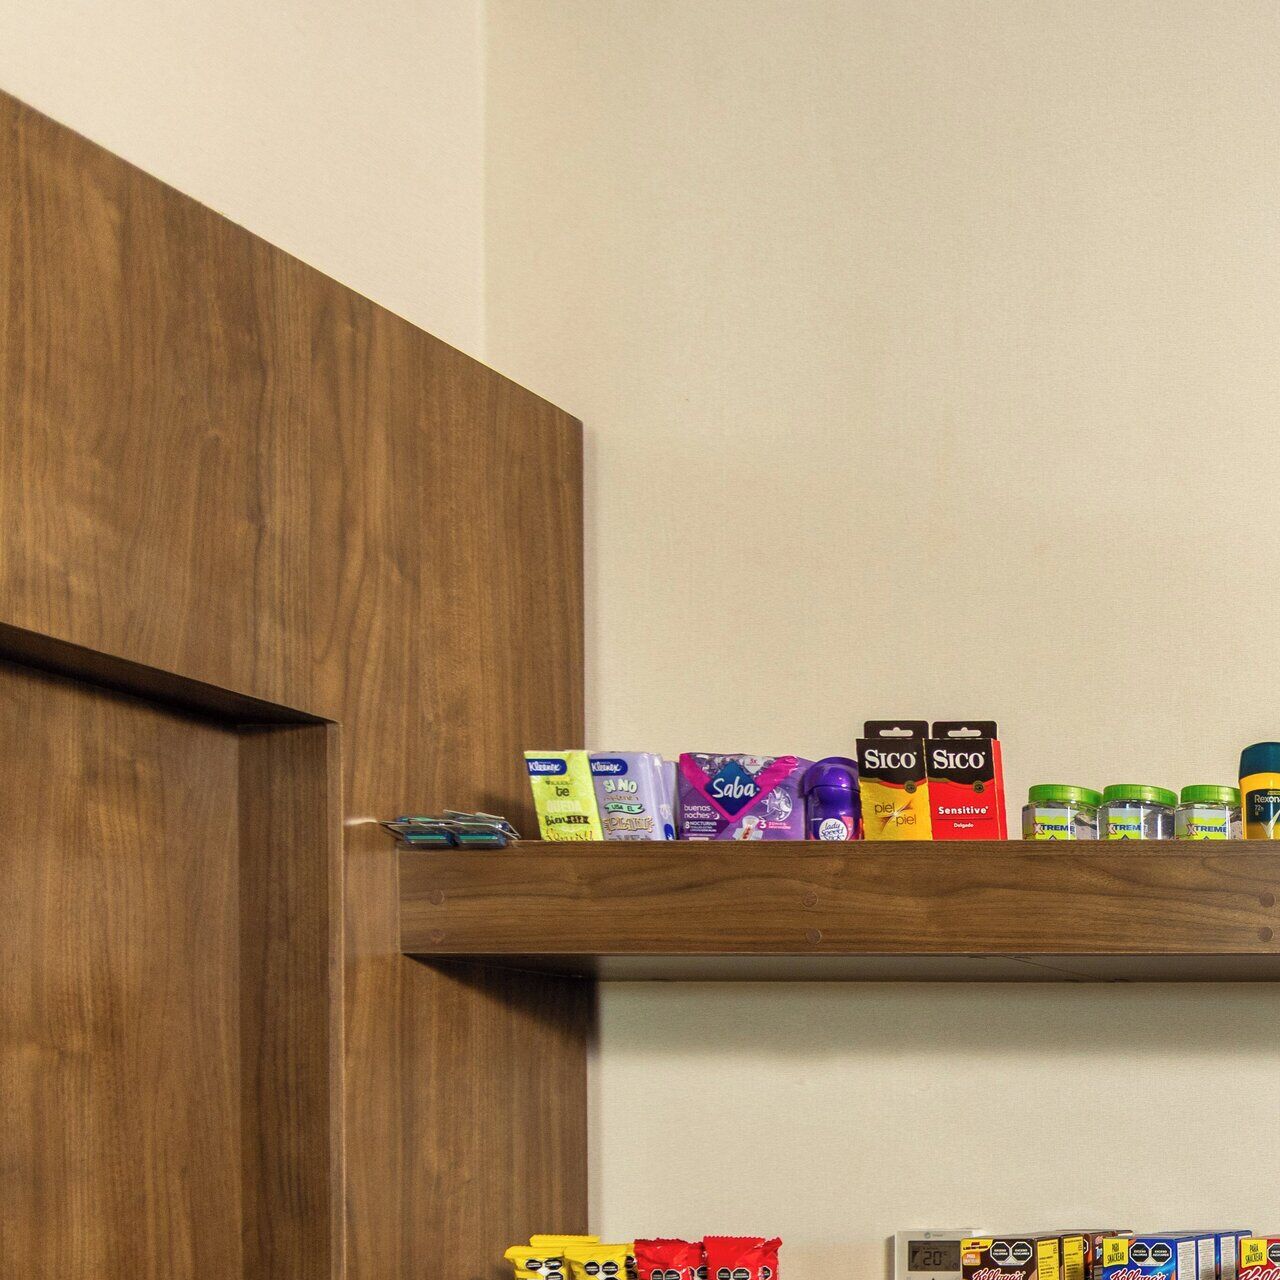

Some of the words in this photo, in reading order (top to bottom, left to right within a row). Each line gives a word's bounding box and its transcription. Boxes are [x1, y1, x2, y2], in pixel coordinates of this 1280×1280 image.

[865, 749, 916, 769] SICO
[933, 749, 985, 769] SICO
[529, 762, 561, 776] Kleenex
[591, 762, 622, 776] Kleenex
[556, 786, 569, 796] te
[618, 778, 638, 793] NO
[712, 776, 757, 799] Saba
[684, 811, 710, 819] noches
[874, 802, 895, 814] piel
[938, 806, 987, 815] Sensitive
[896, 814, 917, 826] piel
[923, 1251, 941, 1266] 20
